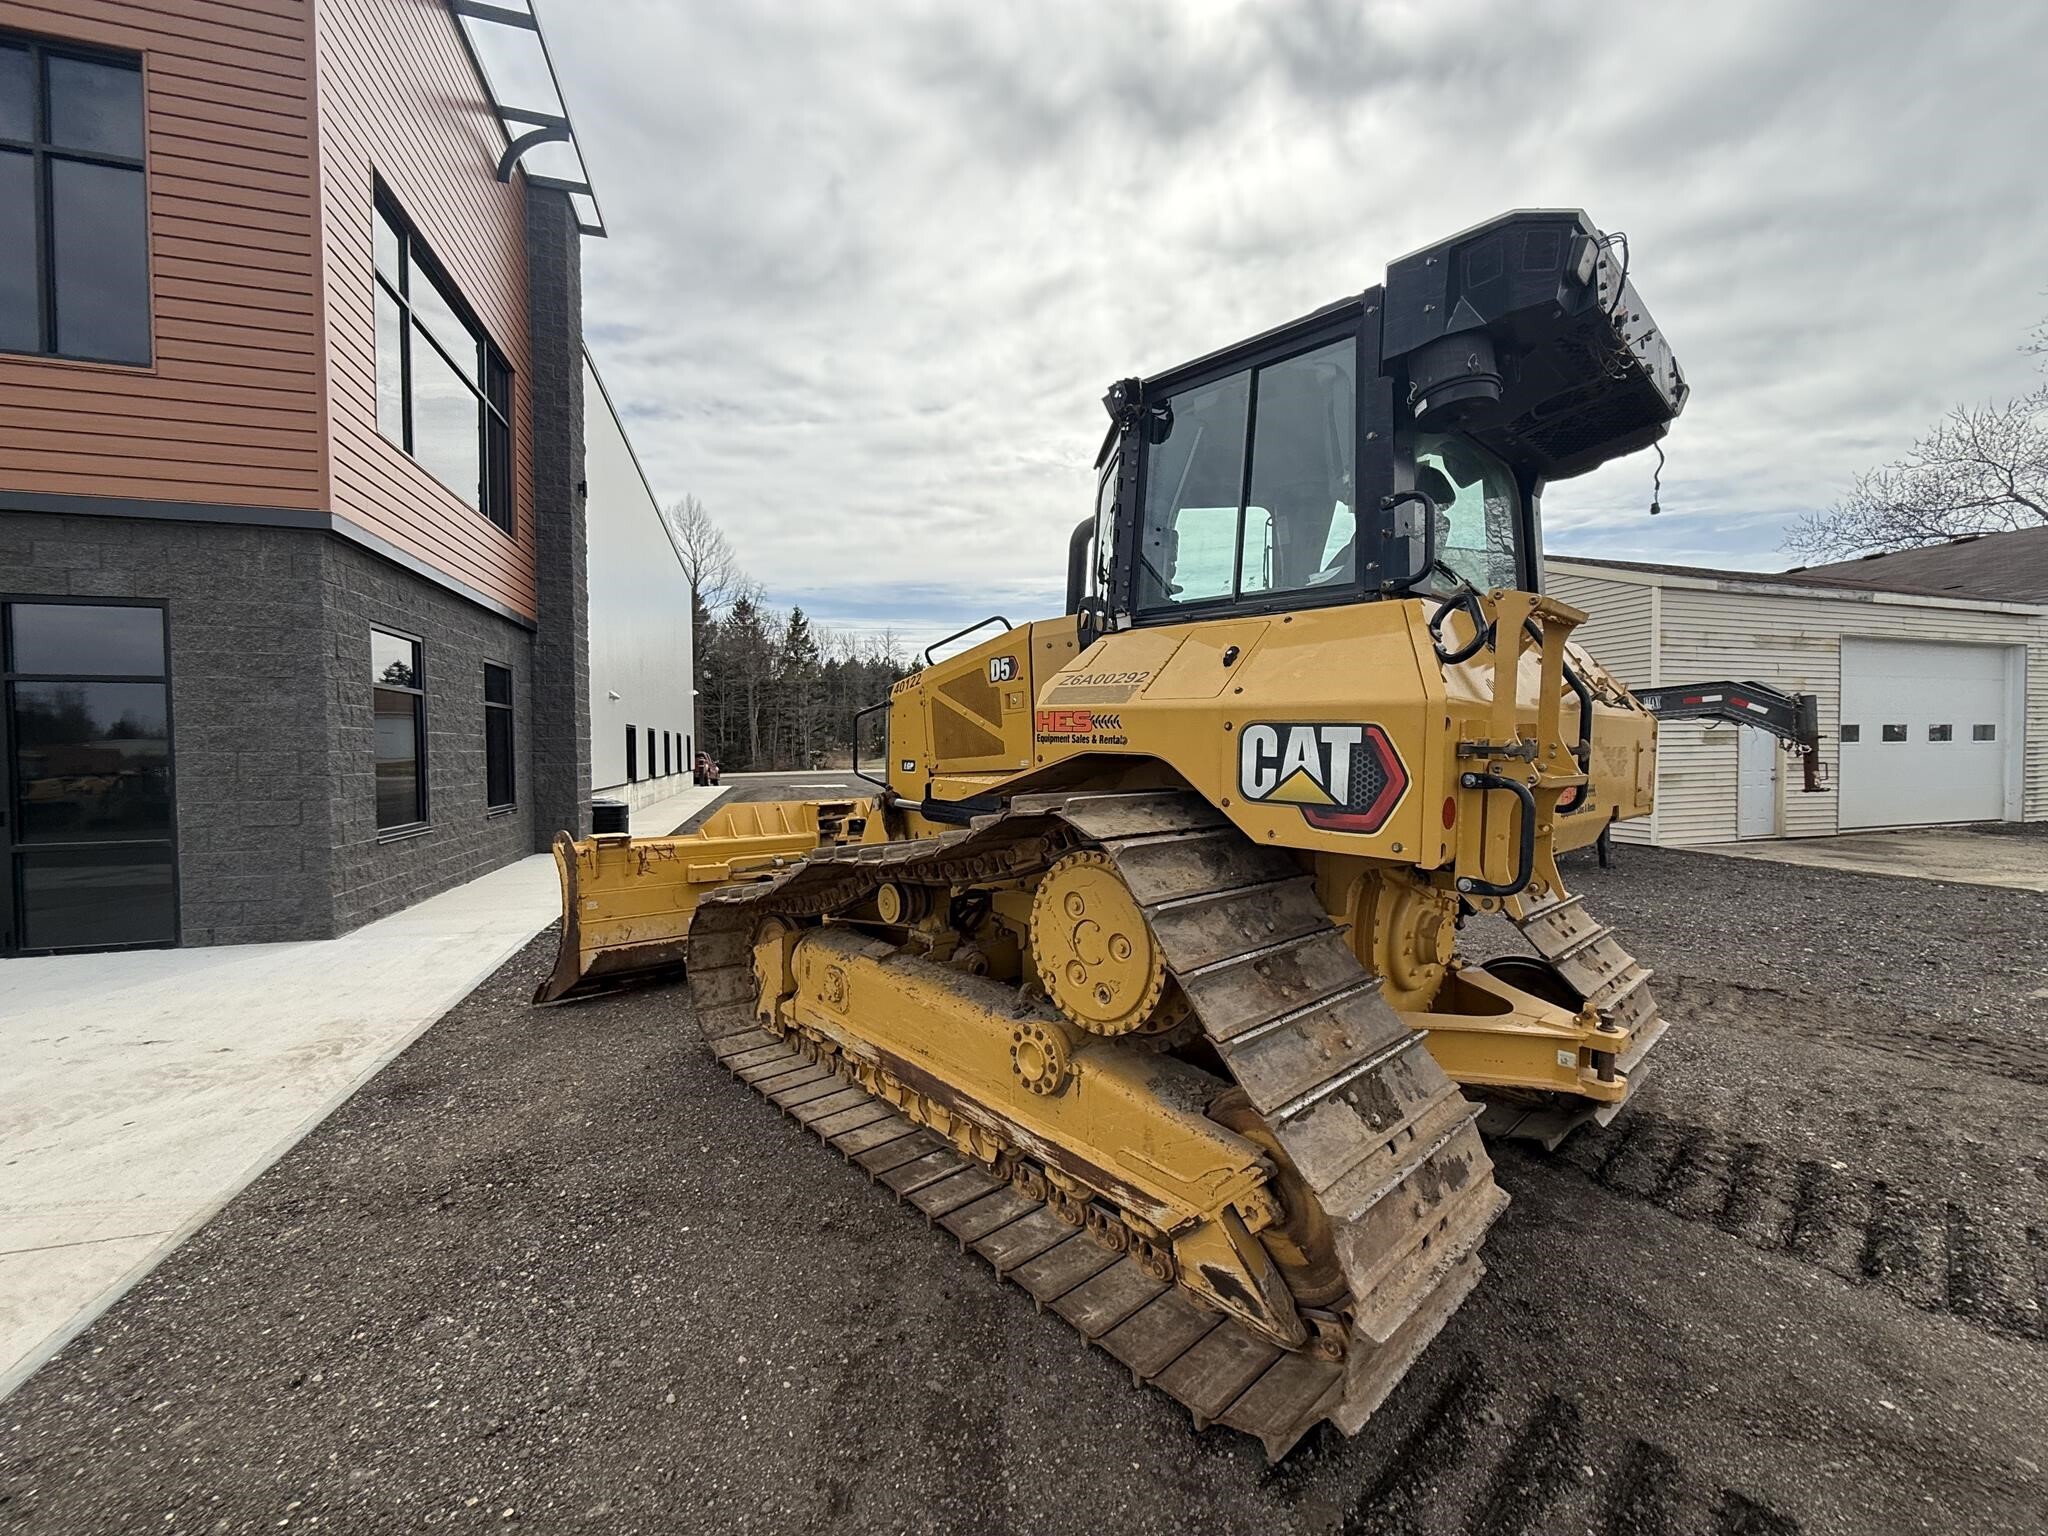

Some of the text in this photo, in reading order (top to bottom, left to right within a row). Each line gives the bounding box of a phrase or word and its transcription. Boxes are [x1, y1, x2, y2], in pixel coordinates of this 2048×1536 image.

[990, 658, 1010, 682] D5
[1058, 671, 1150, 686] Z6A00292
[894, 673, 922, 693] 40122
[1037, 711, 1092, 732] HES
[1037, 734, 1070, 744] Equipment
[1072, 735, 1089, 744] Sales
[1091, 735, 1097, 743] &
[1242, 725, 1362, 805] CAT
